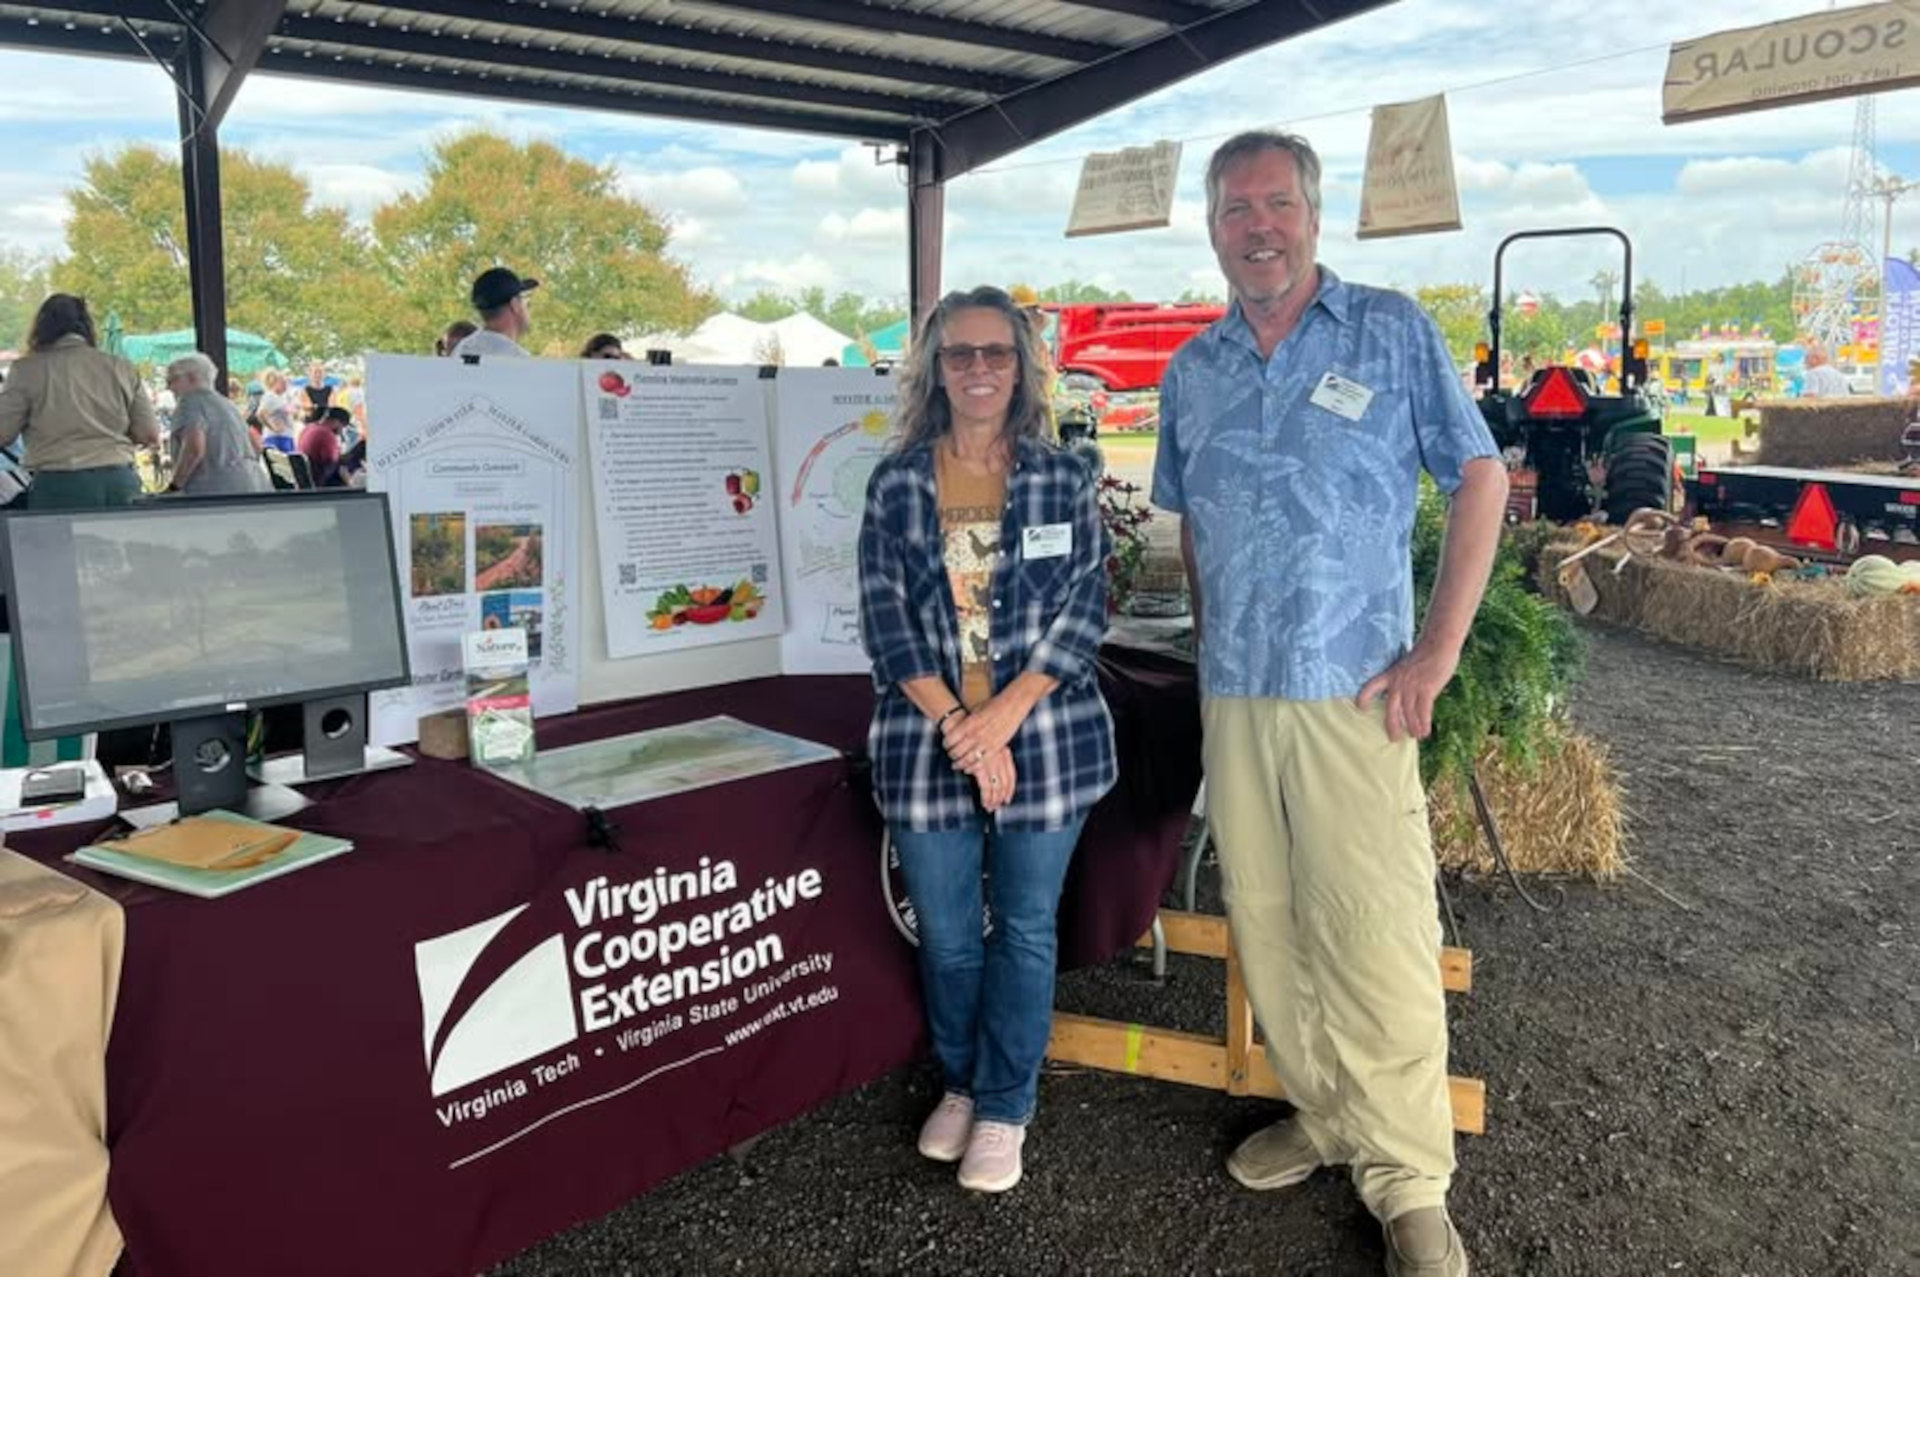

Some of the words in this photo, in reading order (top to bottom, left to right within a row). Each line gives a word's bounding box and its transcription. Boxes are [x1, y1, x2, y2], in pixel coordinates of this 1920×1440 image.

[432, 464, 480, 474] Community
[565, 857, 737, 929] Virginia
[572, 868, 823, 978] Cooperative
[581, 934, 784, 1034] Extension
[617, 1013, 683, 1053] Virginia
[689, 996, 739, 1026] State
[744, 949, 834, 1005] University
[724, 985, 840, 1047] www.ext.vt.edu
[436, 1080, 529, 1128] Virginia
[530, 1053, 581, 1087] Tech
